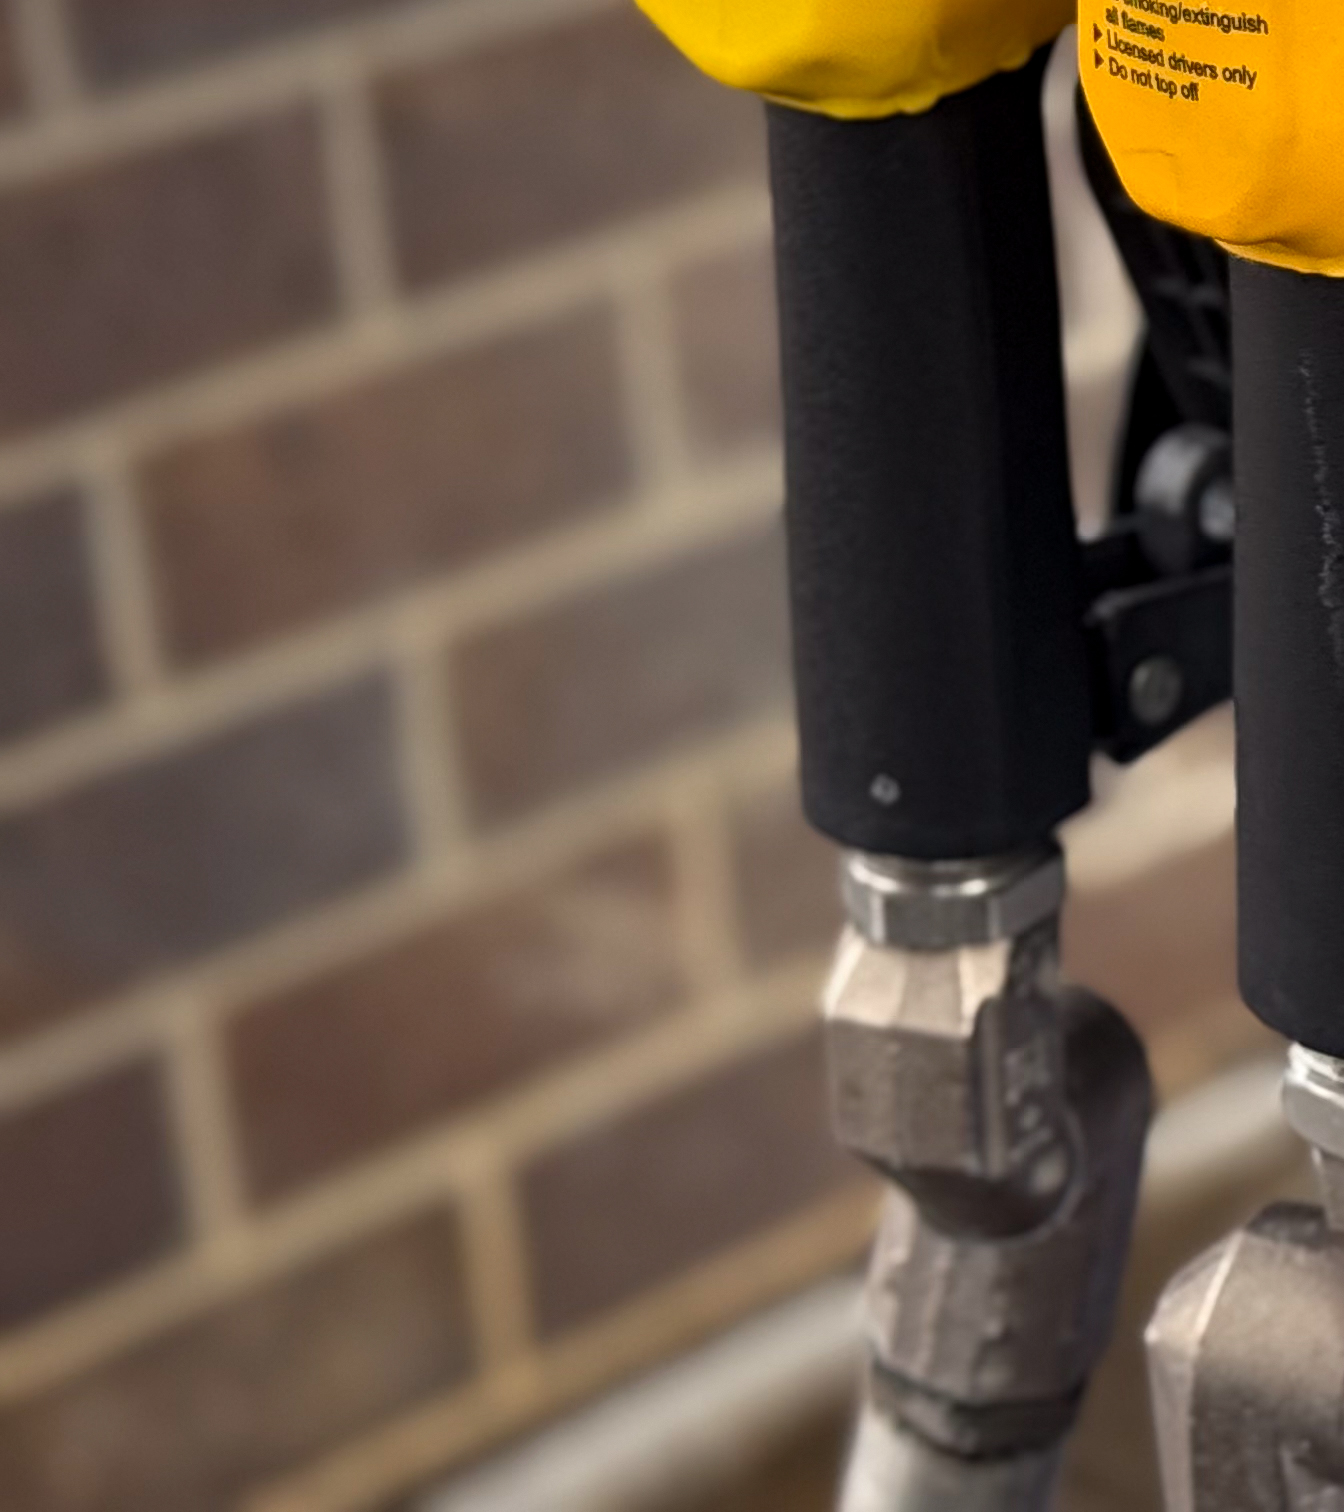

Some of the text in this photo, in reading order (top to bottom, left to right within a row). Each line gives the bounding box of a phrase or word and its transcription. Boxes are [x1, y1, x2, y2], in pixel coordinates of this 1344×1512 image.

[1121, 10, 1165, 43] flames
[1106, 29, 1257, 90] Licensed drivers only
[1108, 56, 1200, 101] Do not top off
